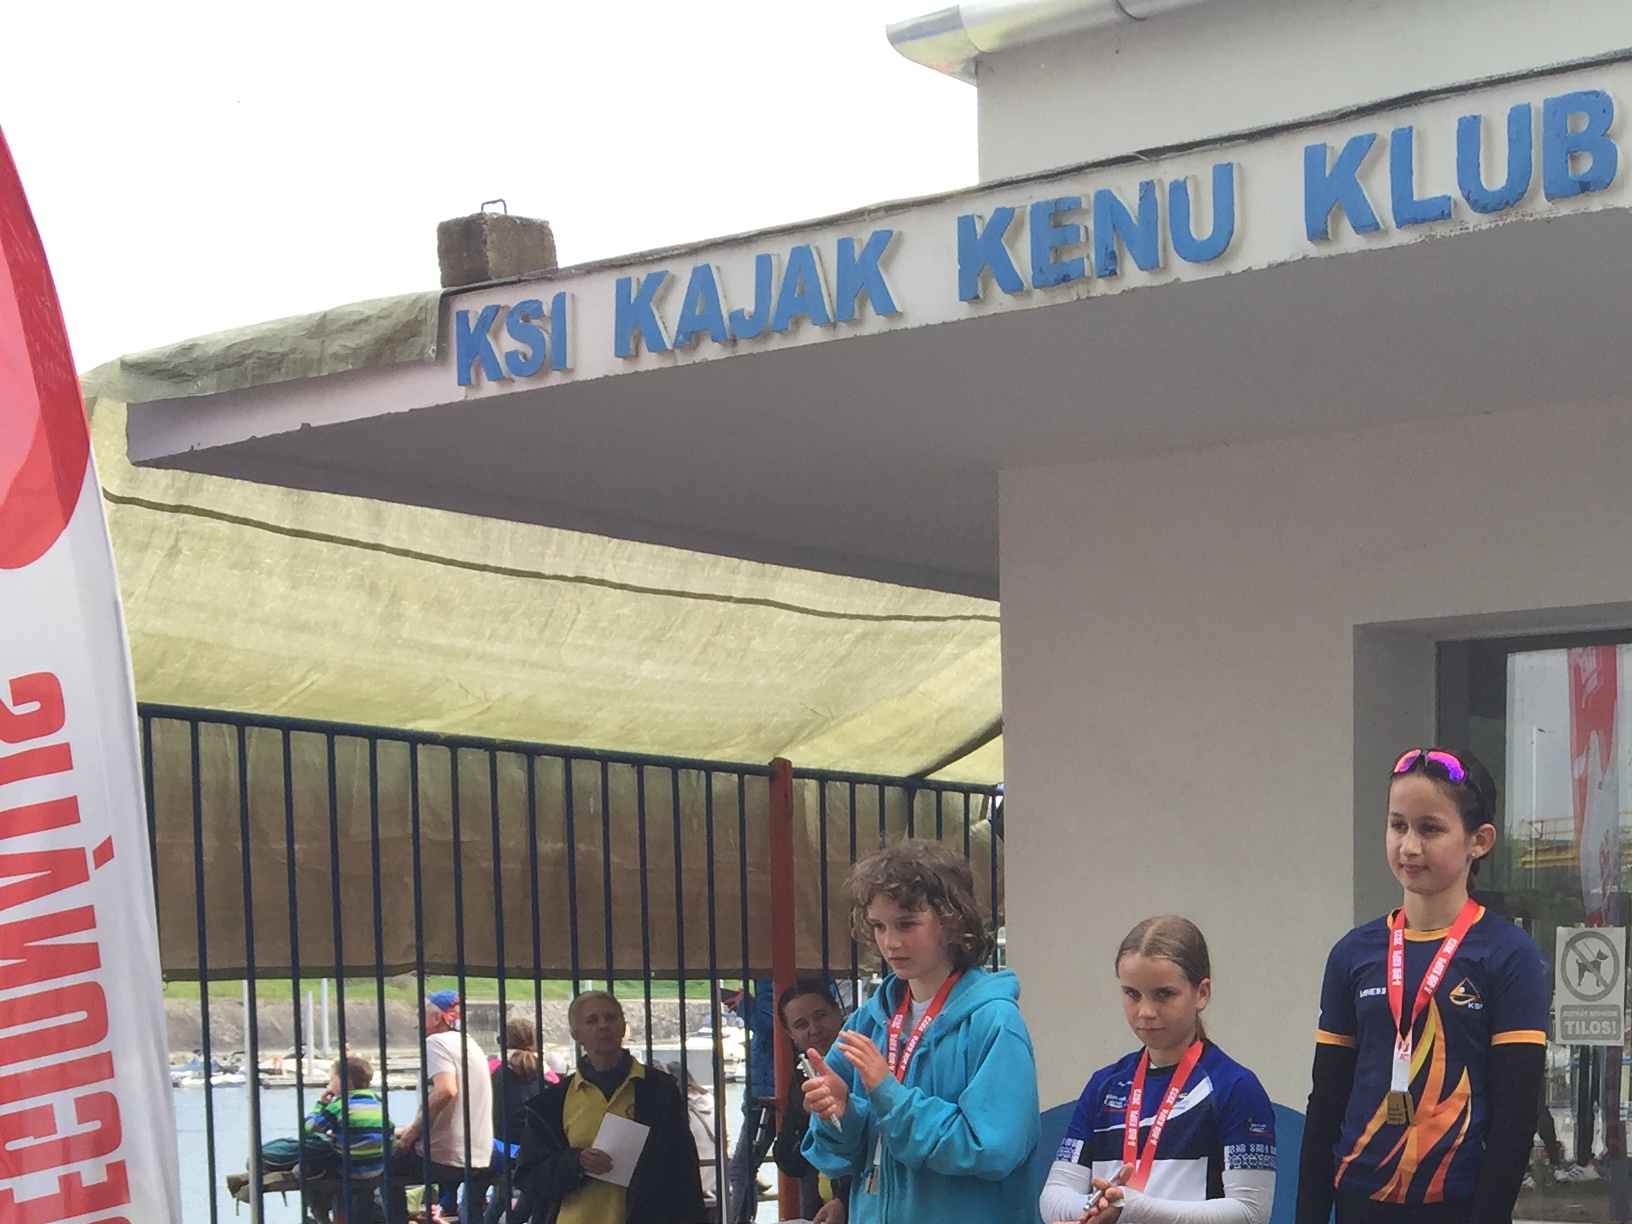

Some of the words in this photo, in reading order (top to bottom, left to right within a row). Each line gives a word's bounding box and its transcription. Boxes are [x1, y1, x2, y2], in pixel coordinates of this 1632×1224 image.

[456, 291, 571, 387] KSI
[613, 229, 902, 360] KAJAK
[958, 161, 1237, 303] KENU
[1304, 89, 1621, 243] KLUB
[1564, 1020, 1617, 1035] TILOS!
